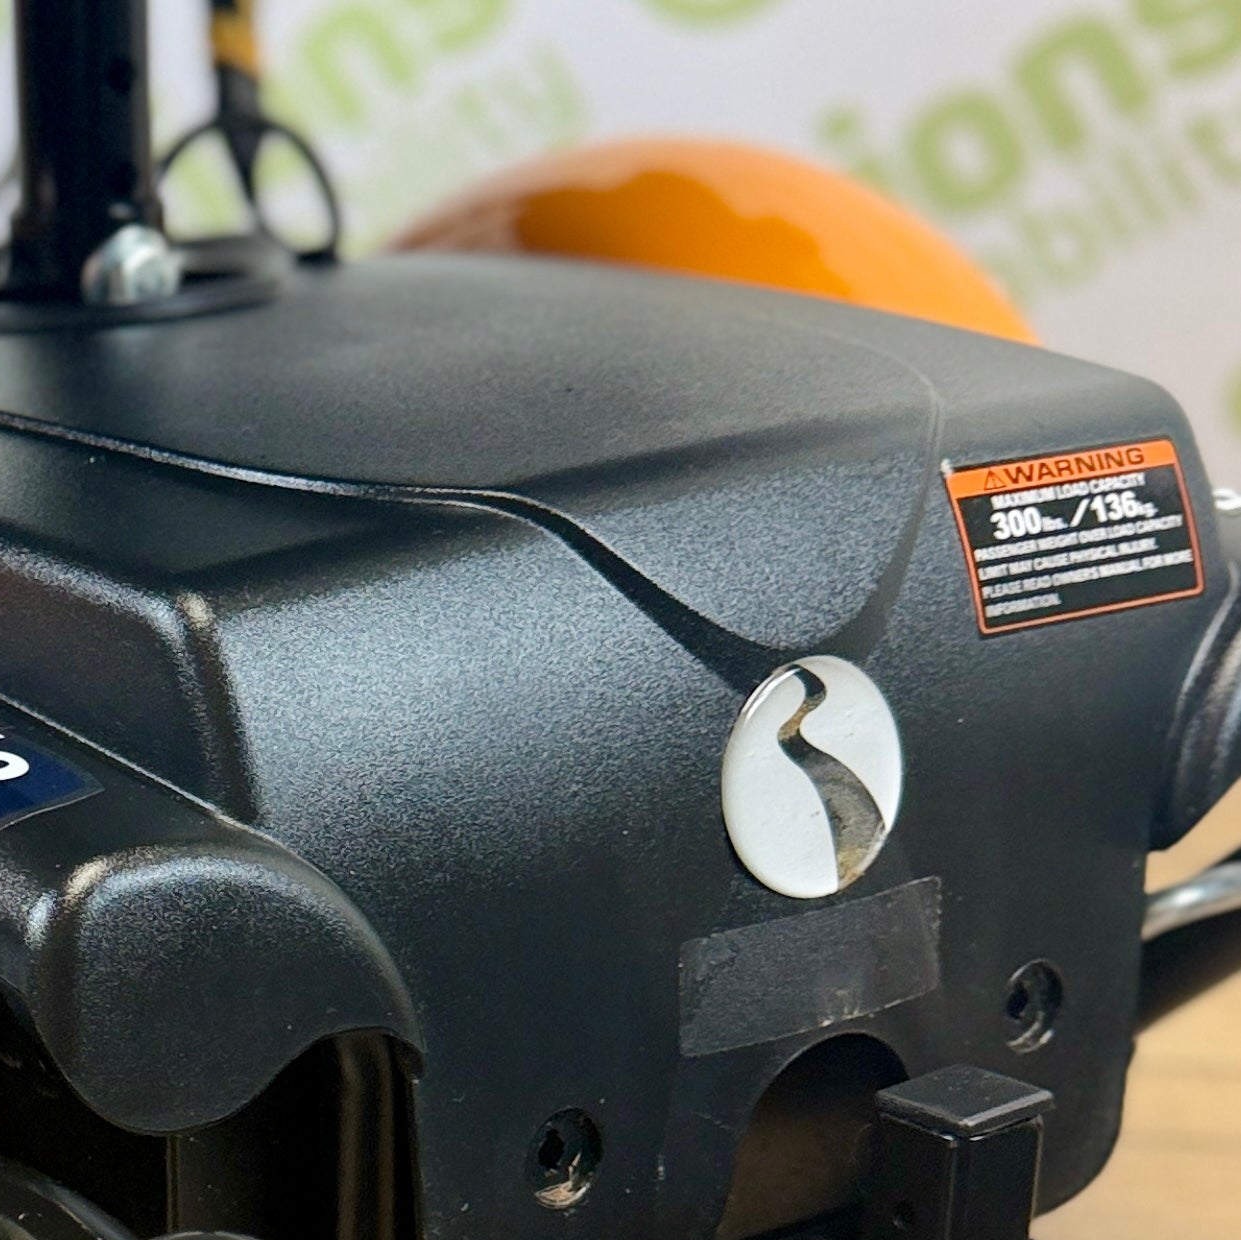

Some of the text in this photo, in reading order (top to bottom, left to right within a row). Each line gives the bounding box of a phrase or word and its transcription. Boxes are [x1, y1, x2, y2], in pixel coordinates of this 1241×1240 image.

[1004, 447, 1145, 484] WARNING
[991, 472, 1146, 509] MAXIMUM LOAD CAPACITY
[974, 540, 1037, 561] PASSENGER
[1078, 528, 1106, 543] OVER
[1106, 523, 1134, 538] LOAD
[1135, 515, 1183, 533] CAPACITY
[981, 580, 1023, 598] PLEASE
